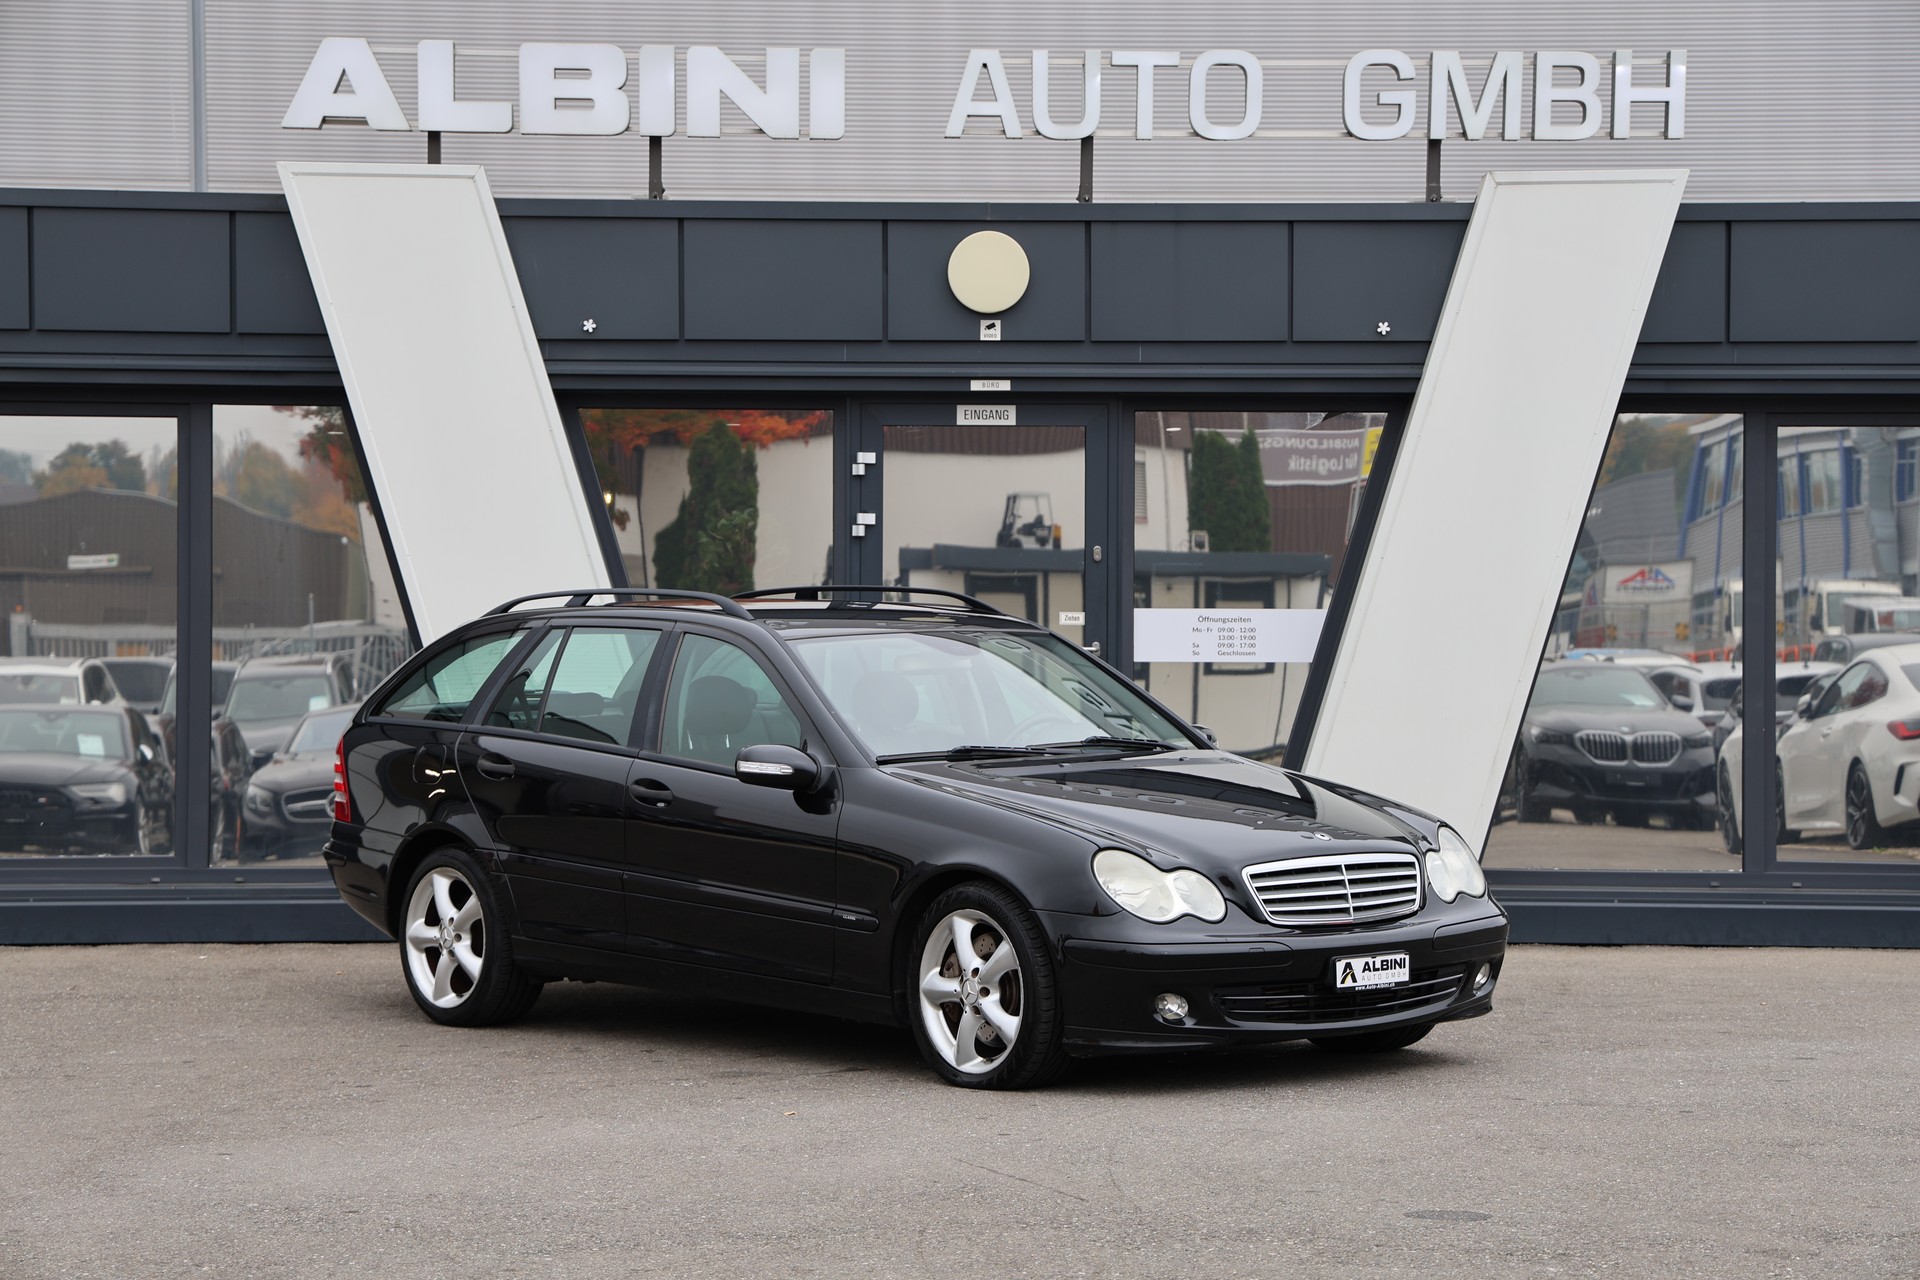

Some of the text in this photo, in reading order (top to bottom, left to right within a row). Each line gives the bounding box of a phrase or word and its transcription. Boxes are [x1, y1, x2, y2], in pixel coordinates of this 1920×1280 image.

[281, 37, 1688, 142] ALBINI AUTO GMBH
[963, 409, 1010, 420] EINGANG
[1197, 615, 1252, 624] Öffnungszeiten
[1361, 957, 1407, 973] ALBINI
[1361, 971, 1407, 982] AUTO GMBH
